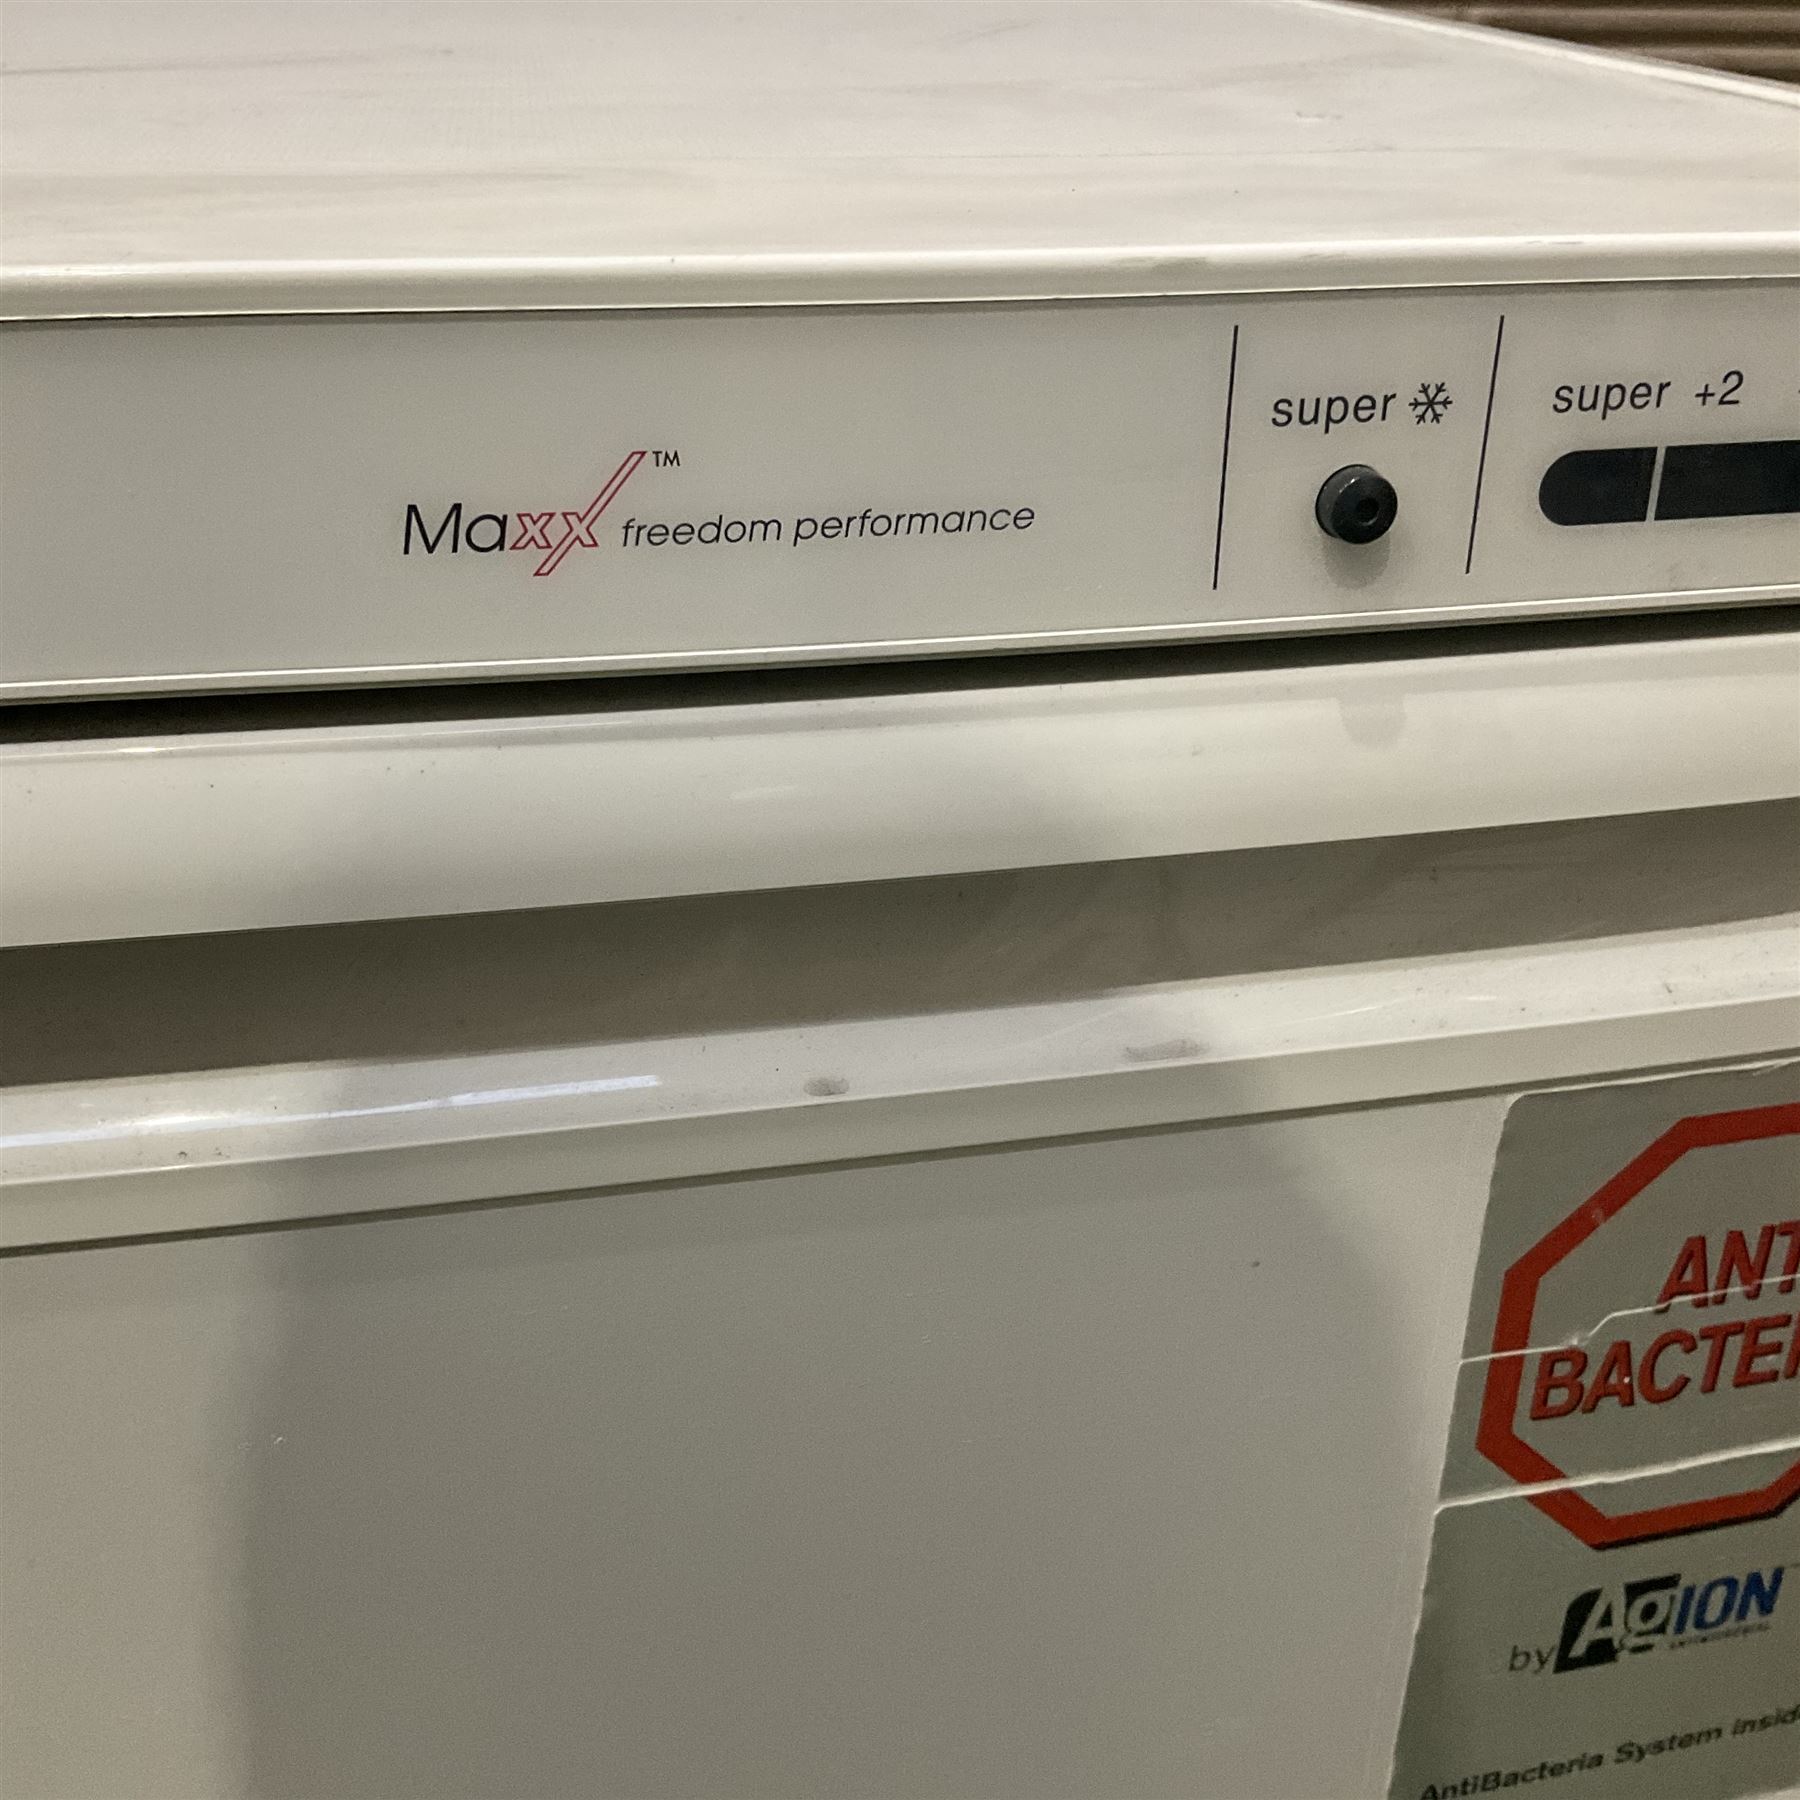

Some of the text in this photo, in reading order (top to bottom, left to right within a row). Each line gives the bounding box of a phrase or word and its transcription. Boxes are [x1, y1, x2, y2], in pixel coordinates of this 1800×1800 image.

[1271, 390, 1396, 434] super
[1552, 370, 1745, 420] super +2
[402, 450, 646, 577] Maxx
[622, 506, 1036, 548] freedom performance
[1508, 1643, 1554, 1676] by
[1419, 1751, 1604, 1800] AntiBacteria
[1614, 1726, 1723, 1765] System
